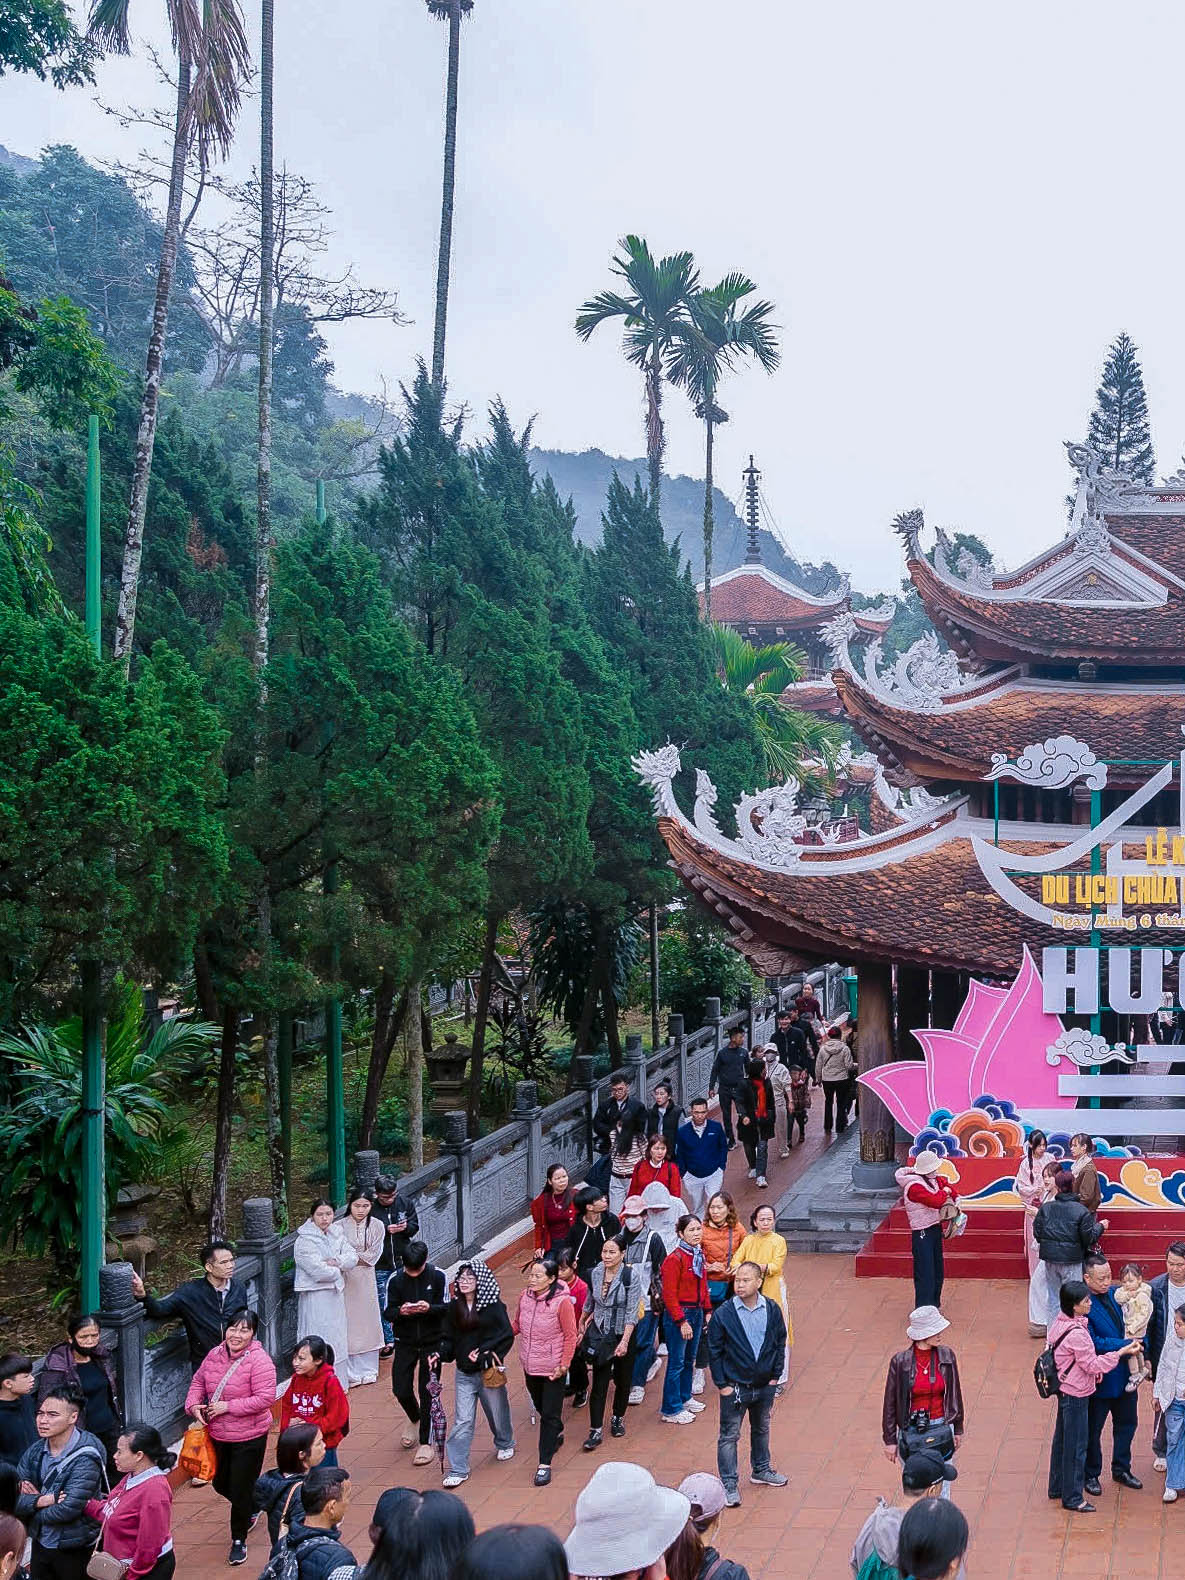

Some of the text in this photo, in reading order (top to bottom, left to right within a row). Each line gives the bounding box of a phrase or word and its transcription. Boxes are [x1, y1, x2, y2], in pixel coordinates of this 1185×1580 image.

[1146, 827, 1168, 864] LỄ
[1042, 875, 1069, 904] DU
[1076, 875, 1118, 908] LỊCH
[1124, 870, 1178, 904] CHÙA
[1053, 915, 1091, 929] Ngày
[1140, 915, 1152, 927] 6
